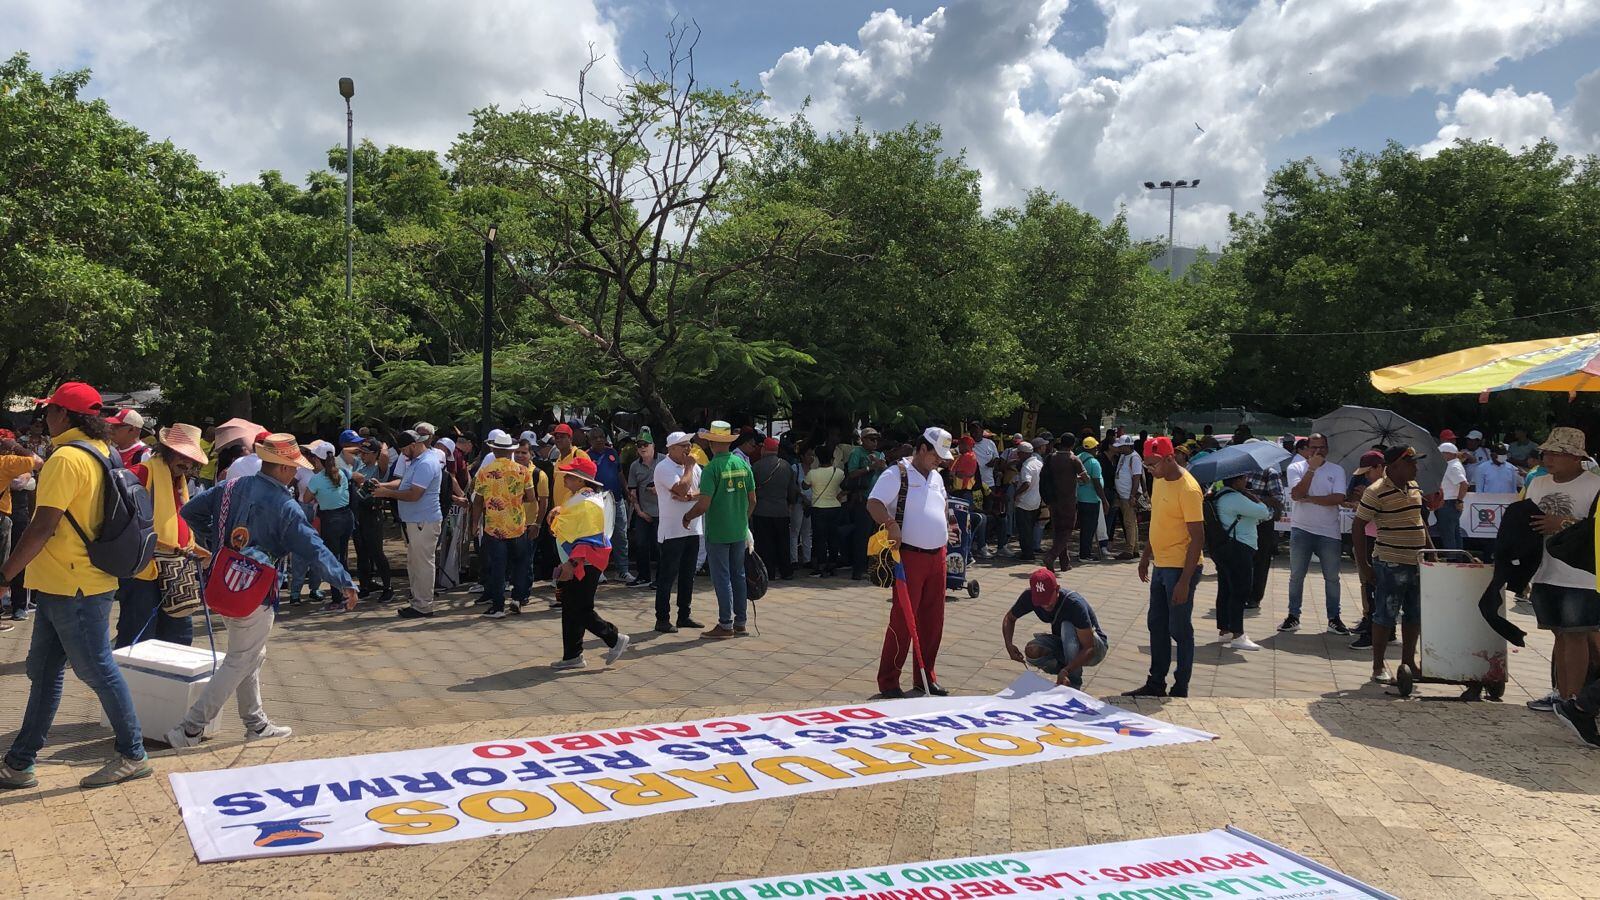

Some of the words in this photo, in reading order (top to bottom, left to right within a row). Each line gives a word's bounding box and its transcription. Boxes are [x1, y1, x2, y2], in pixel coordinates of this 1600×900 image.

[758, 707, 889, 727] DEL
[794, 697, 1101, 743] APOYAMOS
[472, 721, 751, 759] CAMBIO
[658, 733, 796, 762] LAS
[212, 749, 651, 816] REFORMAS
[364, 724, 1112, 835] PORTUARIOS
[901, 859, 1031, 883] CAMBIO
[1098, 851, 1269, 882] APOYAMOS
[751, 875, 868, 900] FAVOR
[865, 872, 895, 887] A
[1014, 872, 1088, 891] LAS
[1202, 879, 1264, 895] LA
[1249, 875, 1288, 889] A
[1279, 871, 1327, 887] SI
